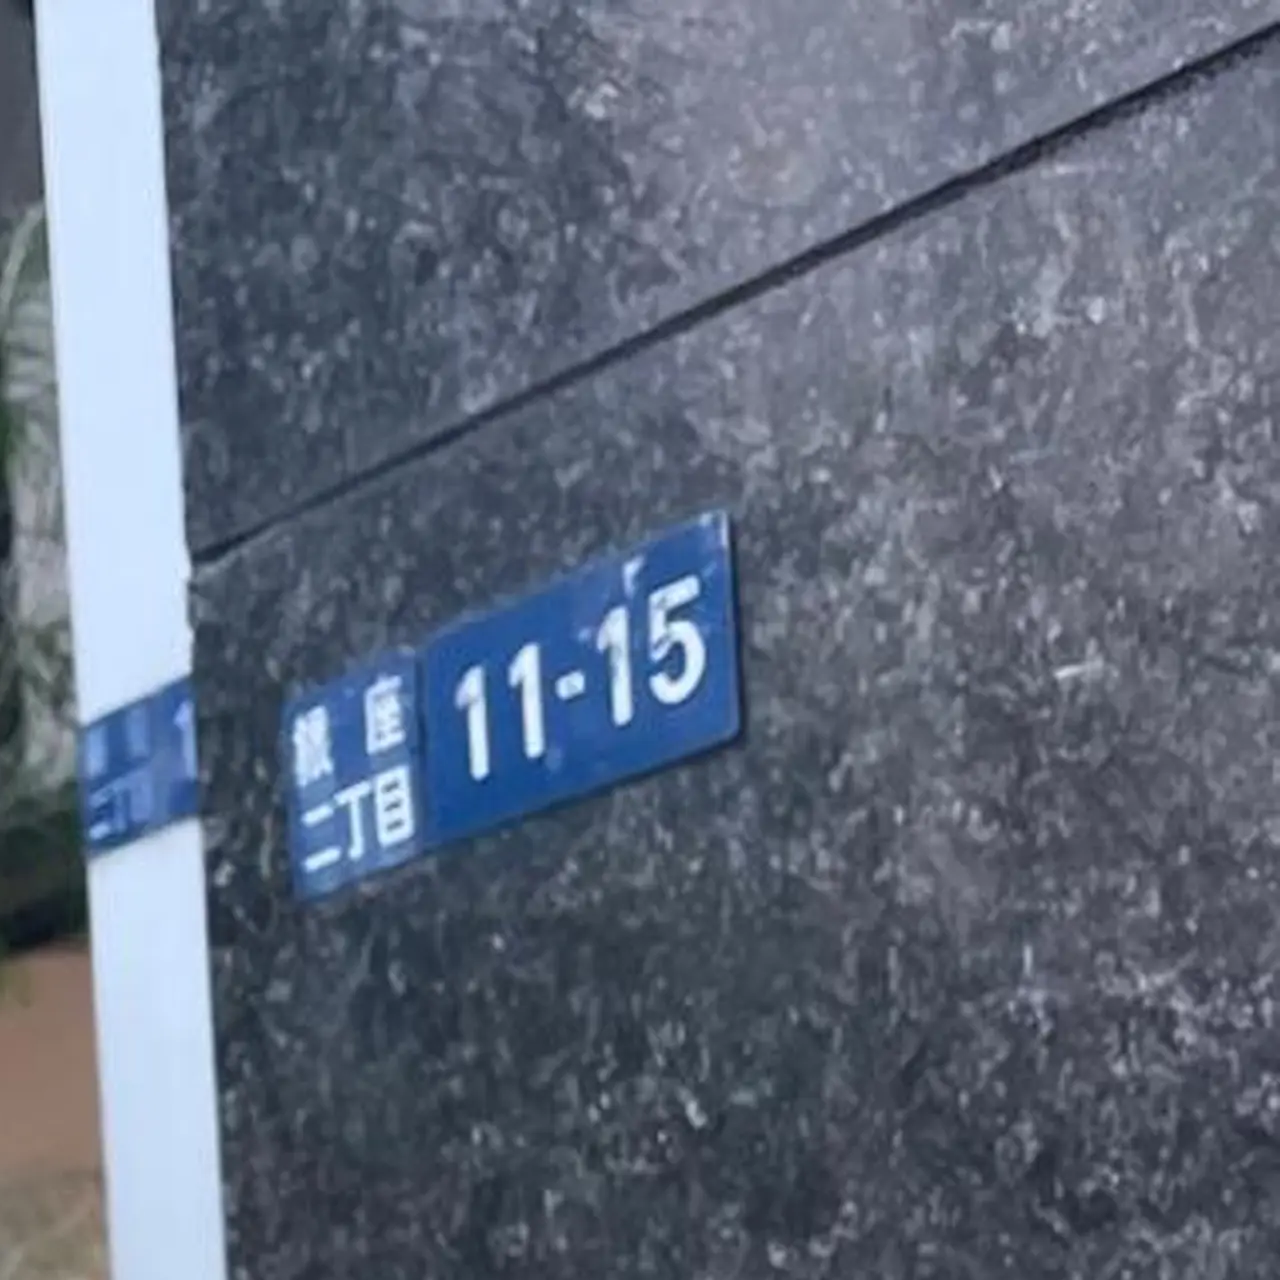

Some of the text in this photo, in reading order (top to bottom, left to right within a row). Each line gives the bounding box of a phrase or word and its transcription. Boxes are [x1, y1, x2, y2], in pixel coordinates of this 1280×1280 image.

[454, 573, 707, 783] 11-15
[300, 764, 416, 873] 二丁目
